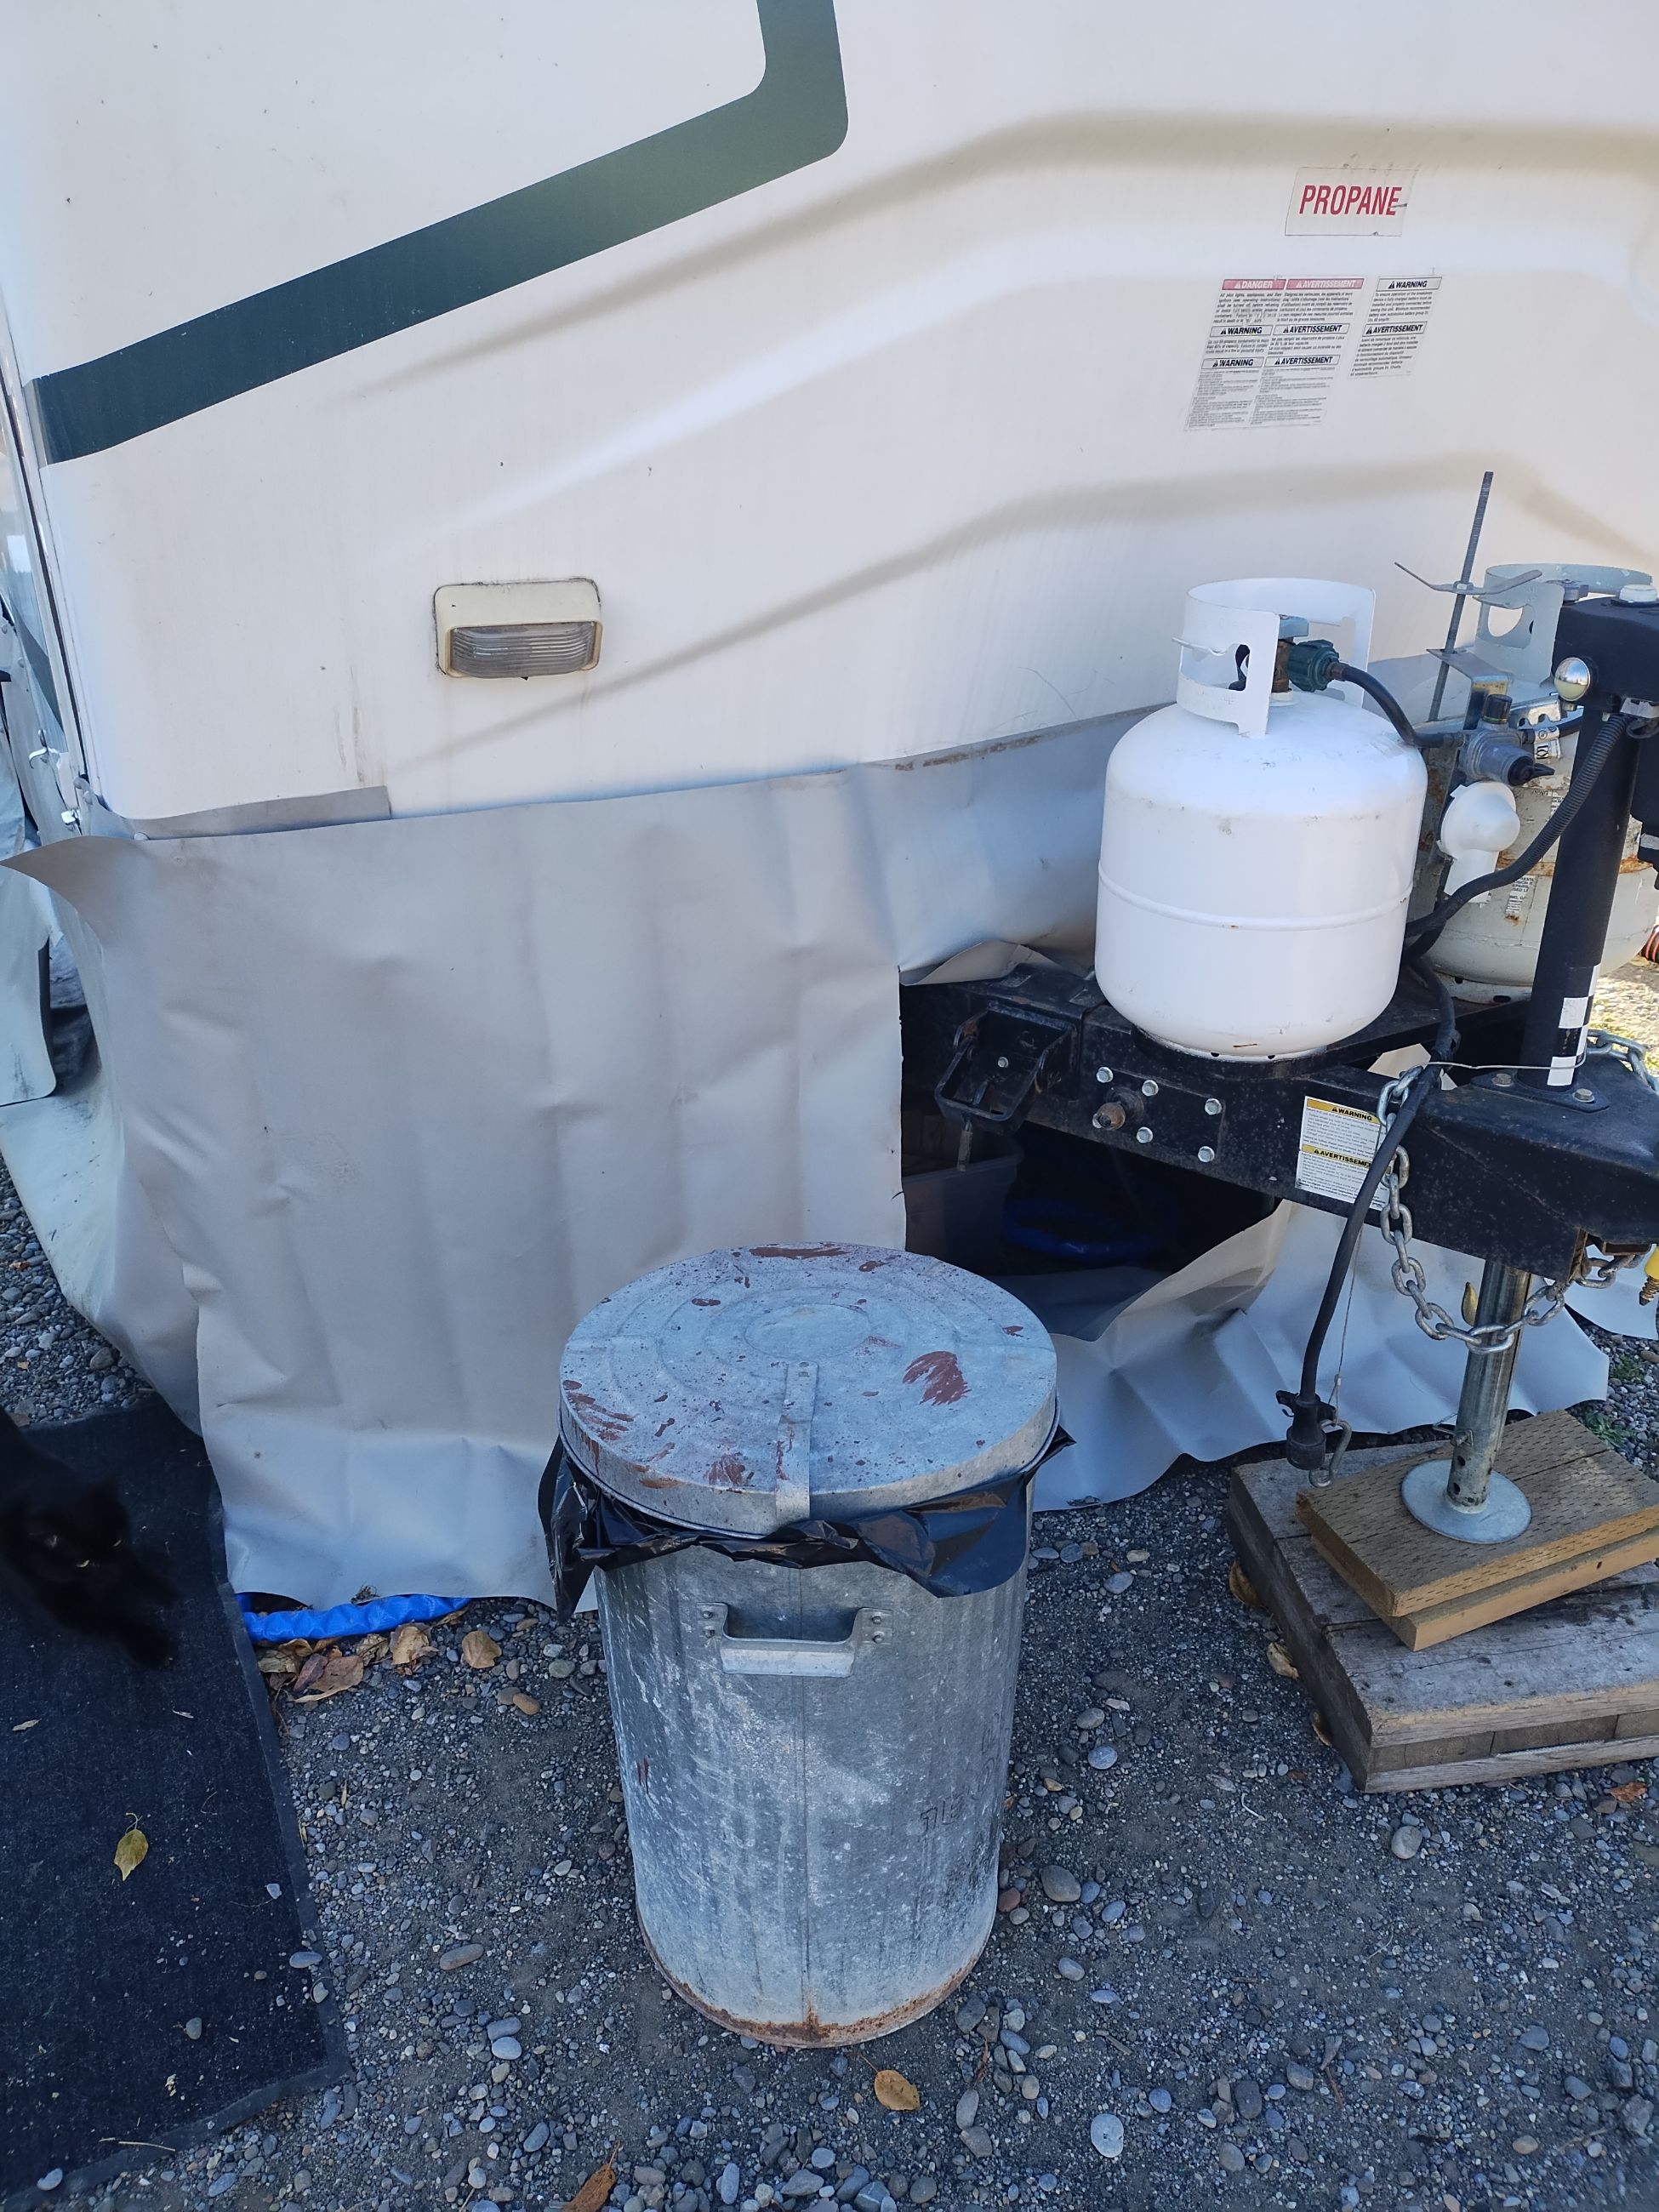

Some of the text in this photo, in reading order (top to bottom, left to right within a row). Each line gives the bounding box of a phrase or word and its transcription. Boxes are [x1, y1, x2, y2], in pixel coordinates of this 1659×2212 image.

[1299, 185, 1402, 215] PROPANE
[1303, 279, 1356, 288] AVERTISSEMENT
[1373, 324, 1422, 333] AVERTISSEMENT
[1338, 1108, 1371, 1120] WARNING
